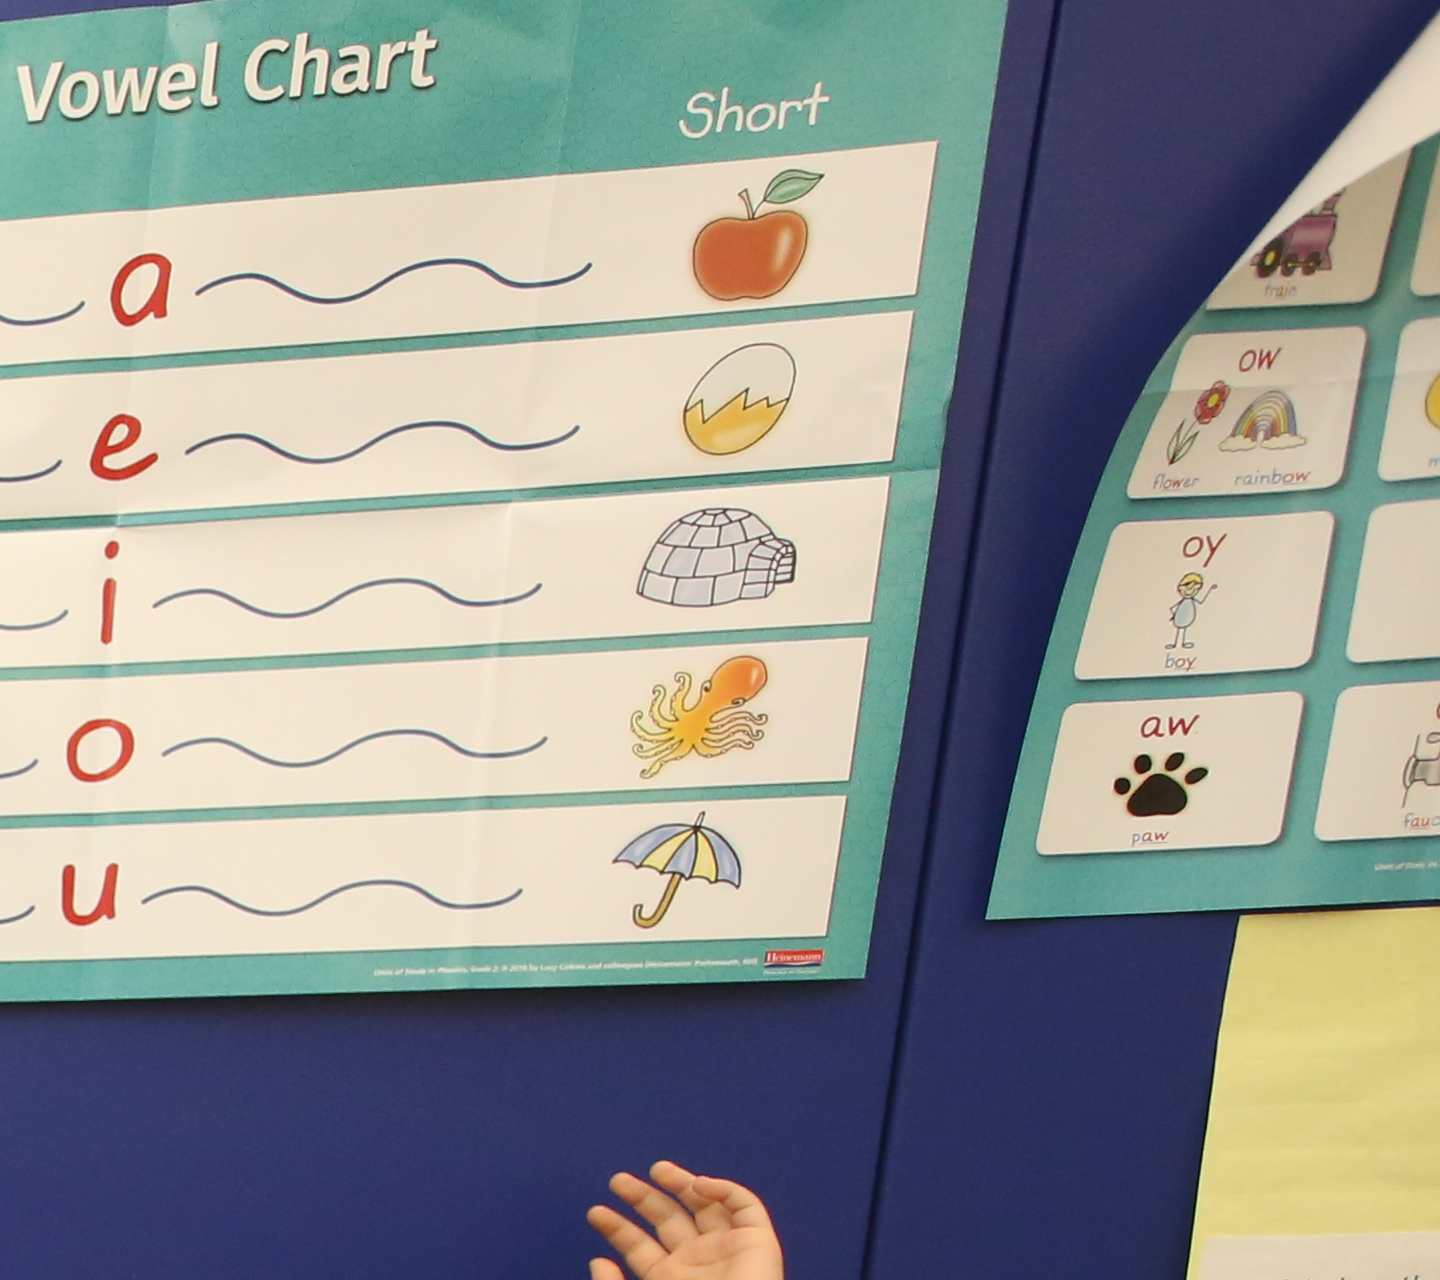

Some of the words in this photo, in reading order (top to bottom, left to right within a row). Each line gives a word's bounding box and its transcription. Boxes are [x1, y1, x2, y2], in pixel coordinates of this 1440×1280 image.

[17, 60, 220, 124] Vowel
[244, 30, 438, 102] Chart
[678, 85, 831, 139] Short
[111, 253, 172, 328] a
[1238, 348, 1282, 372] ow
[88, 413, 158, 479] e
[1234, 469, 1311, 486] rainbow
[1182, 533, 1227, 567] oy
[100, 539, 121, 644] i
[1165, 654, 1197, 671] boy
[66, 718, 134, 784] o
[1140, 715, 1200, 738] aw
[1131, 829, 1169, 846] paw
[61, 860, 119, 928] u
